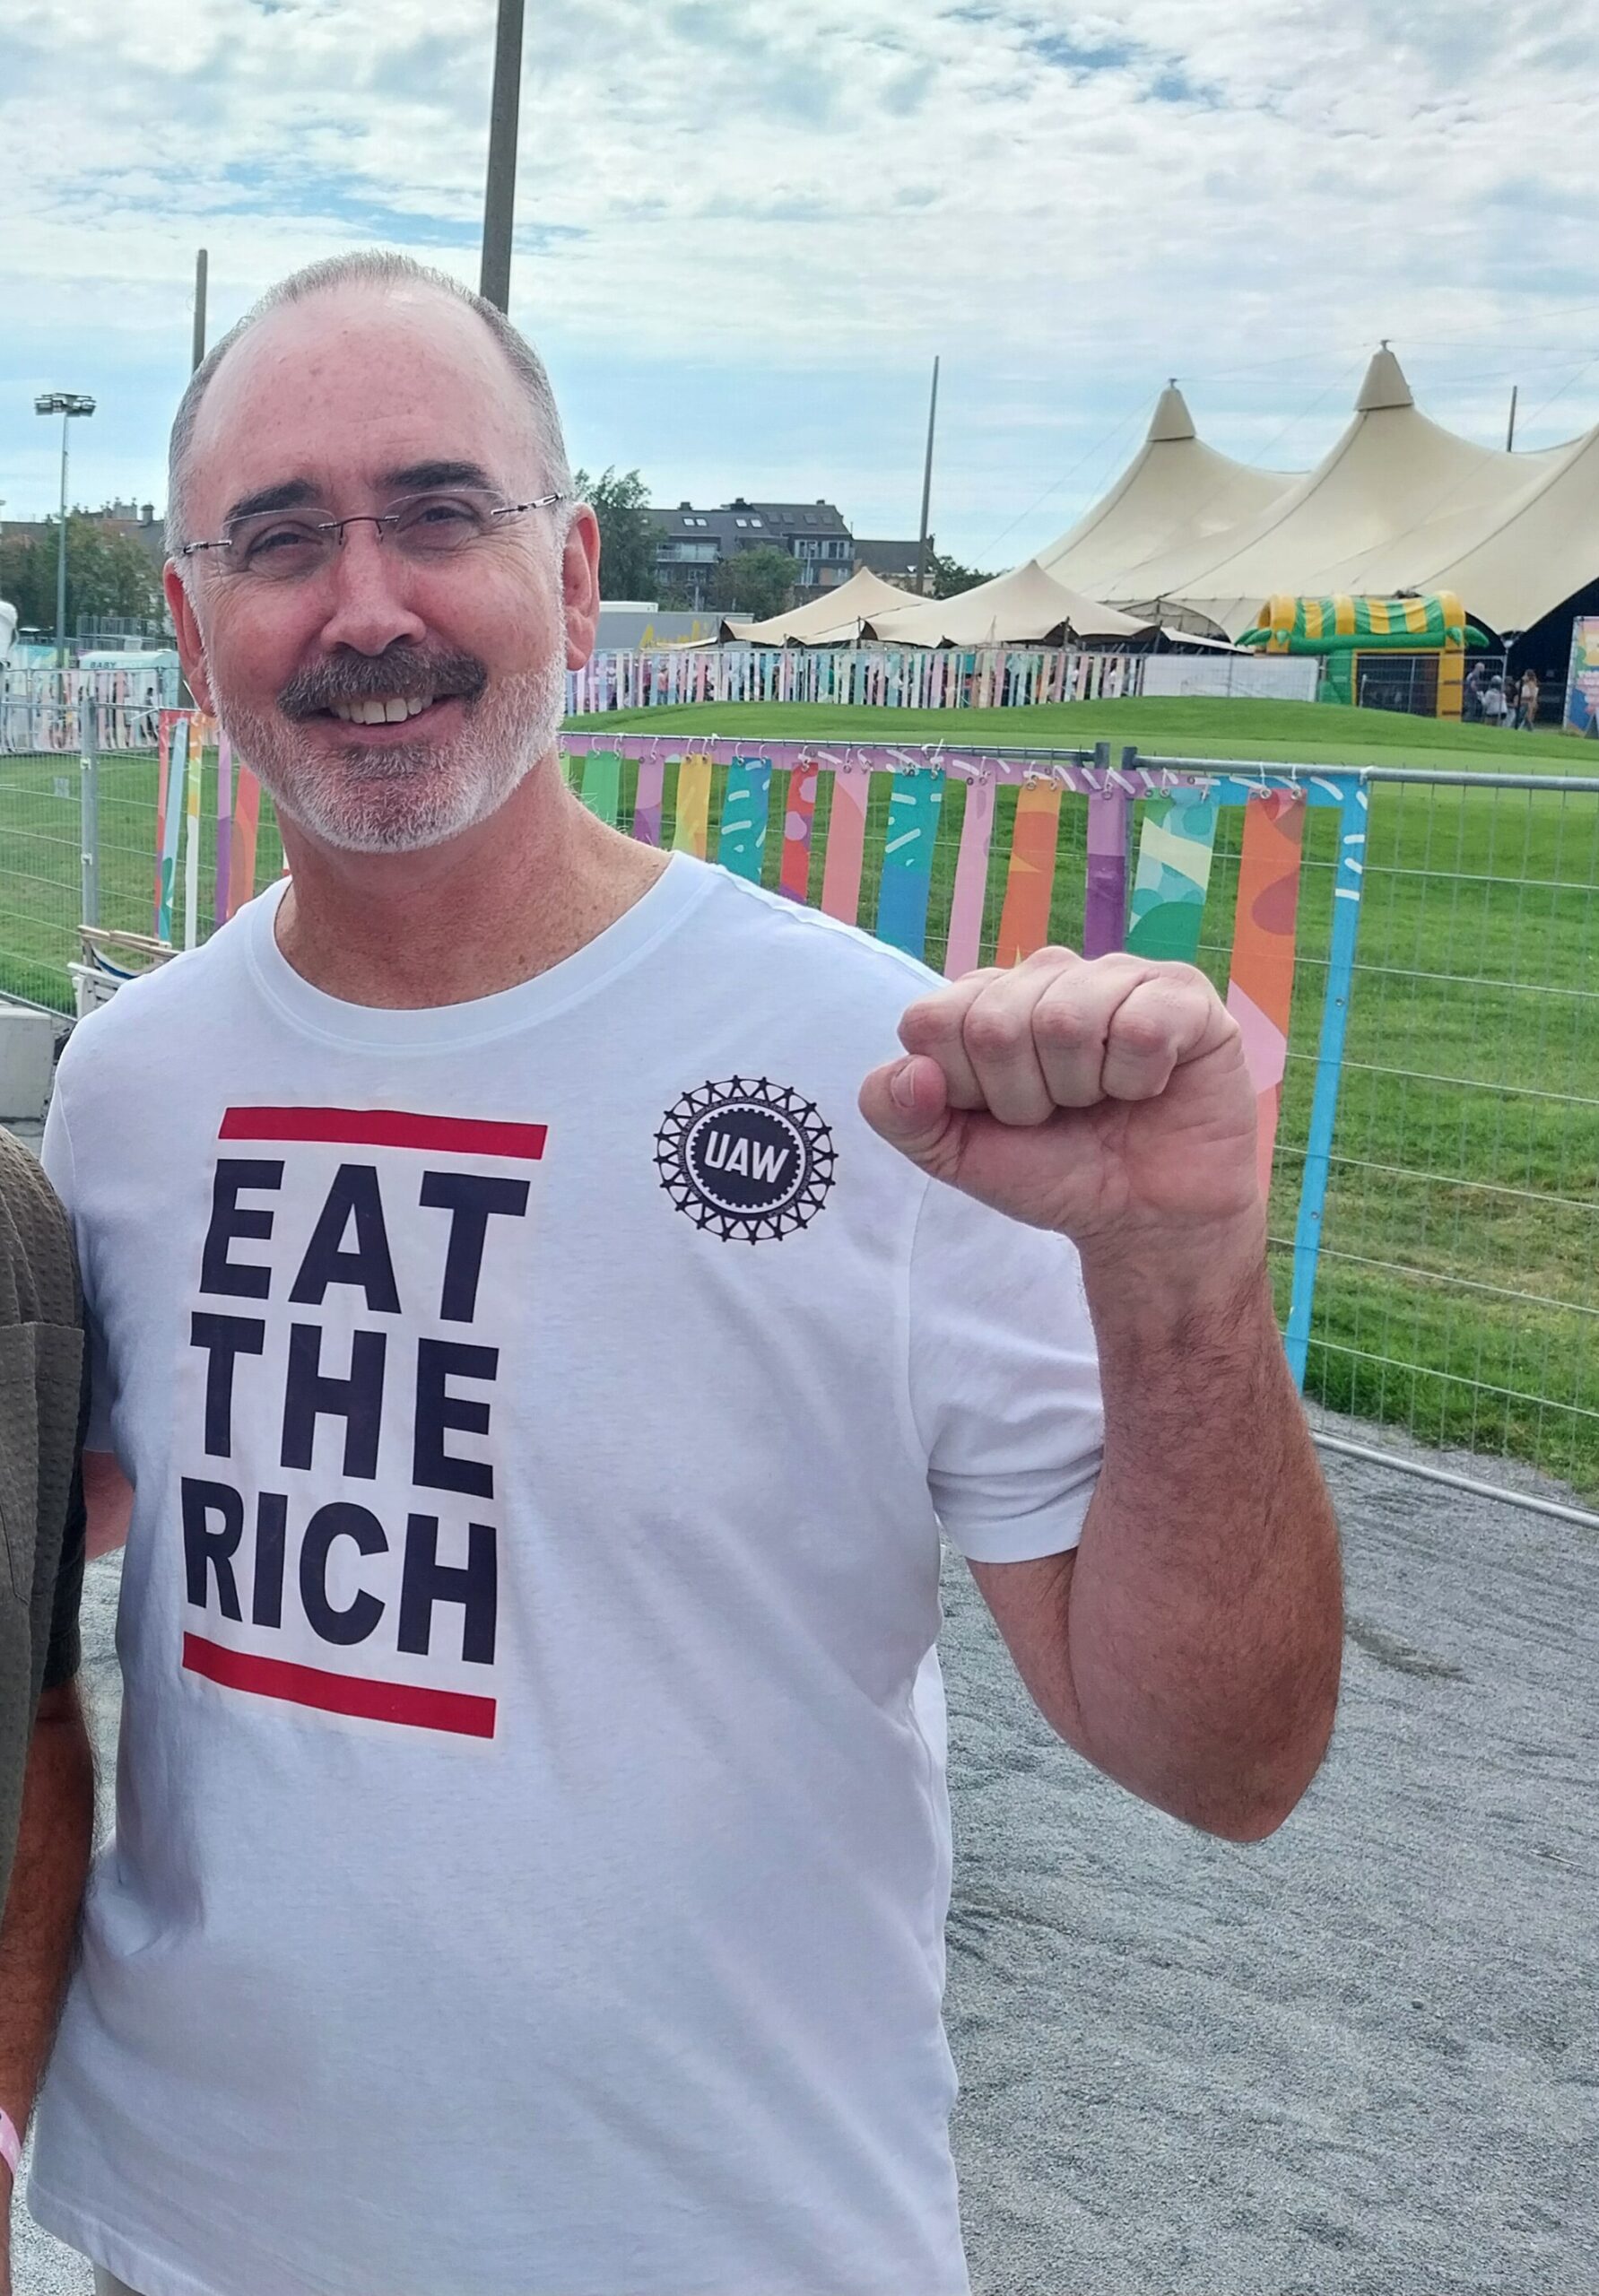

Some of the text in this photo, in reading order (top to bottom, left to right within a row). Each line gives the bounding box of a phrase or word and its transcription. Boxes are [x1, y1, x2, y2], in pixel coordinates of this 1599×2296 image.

[91, 661, 117, 669] BABY
[704, 1130, 789, 1183] UAW
[199, 1159, 530, 1323] EAT
[190, 1311, 499, 1500] THE
[181, 1476, 497, 1665] RICH
